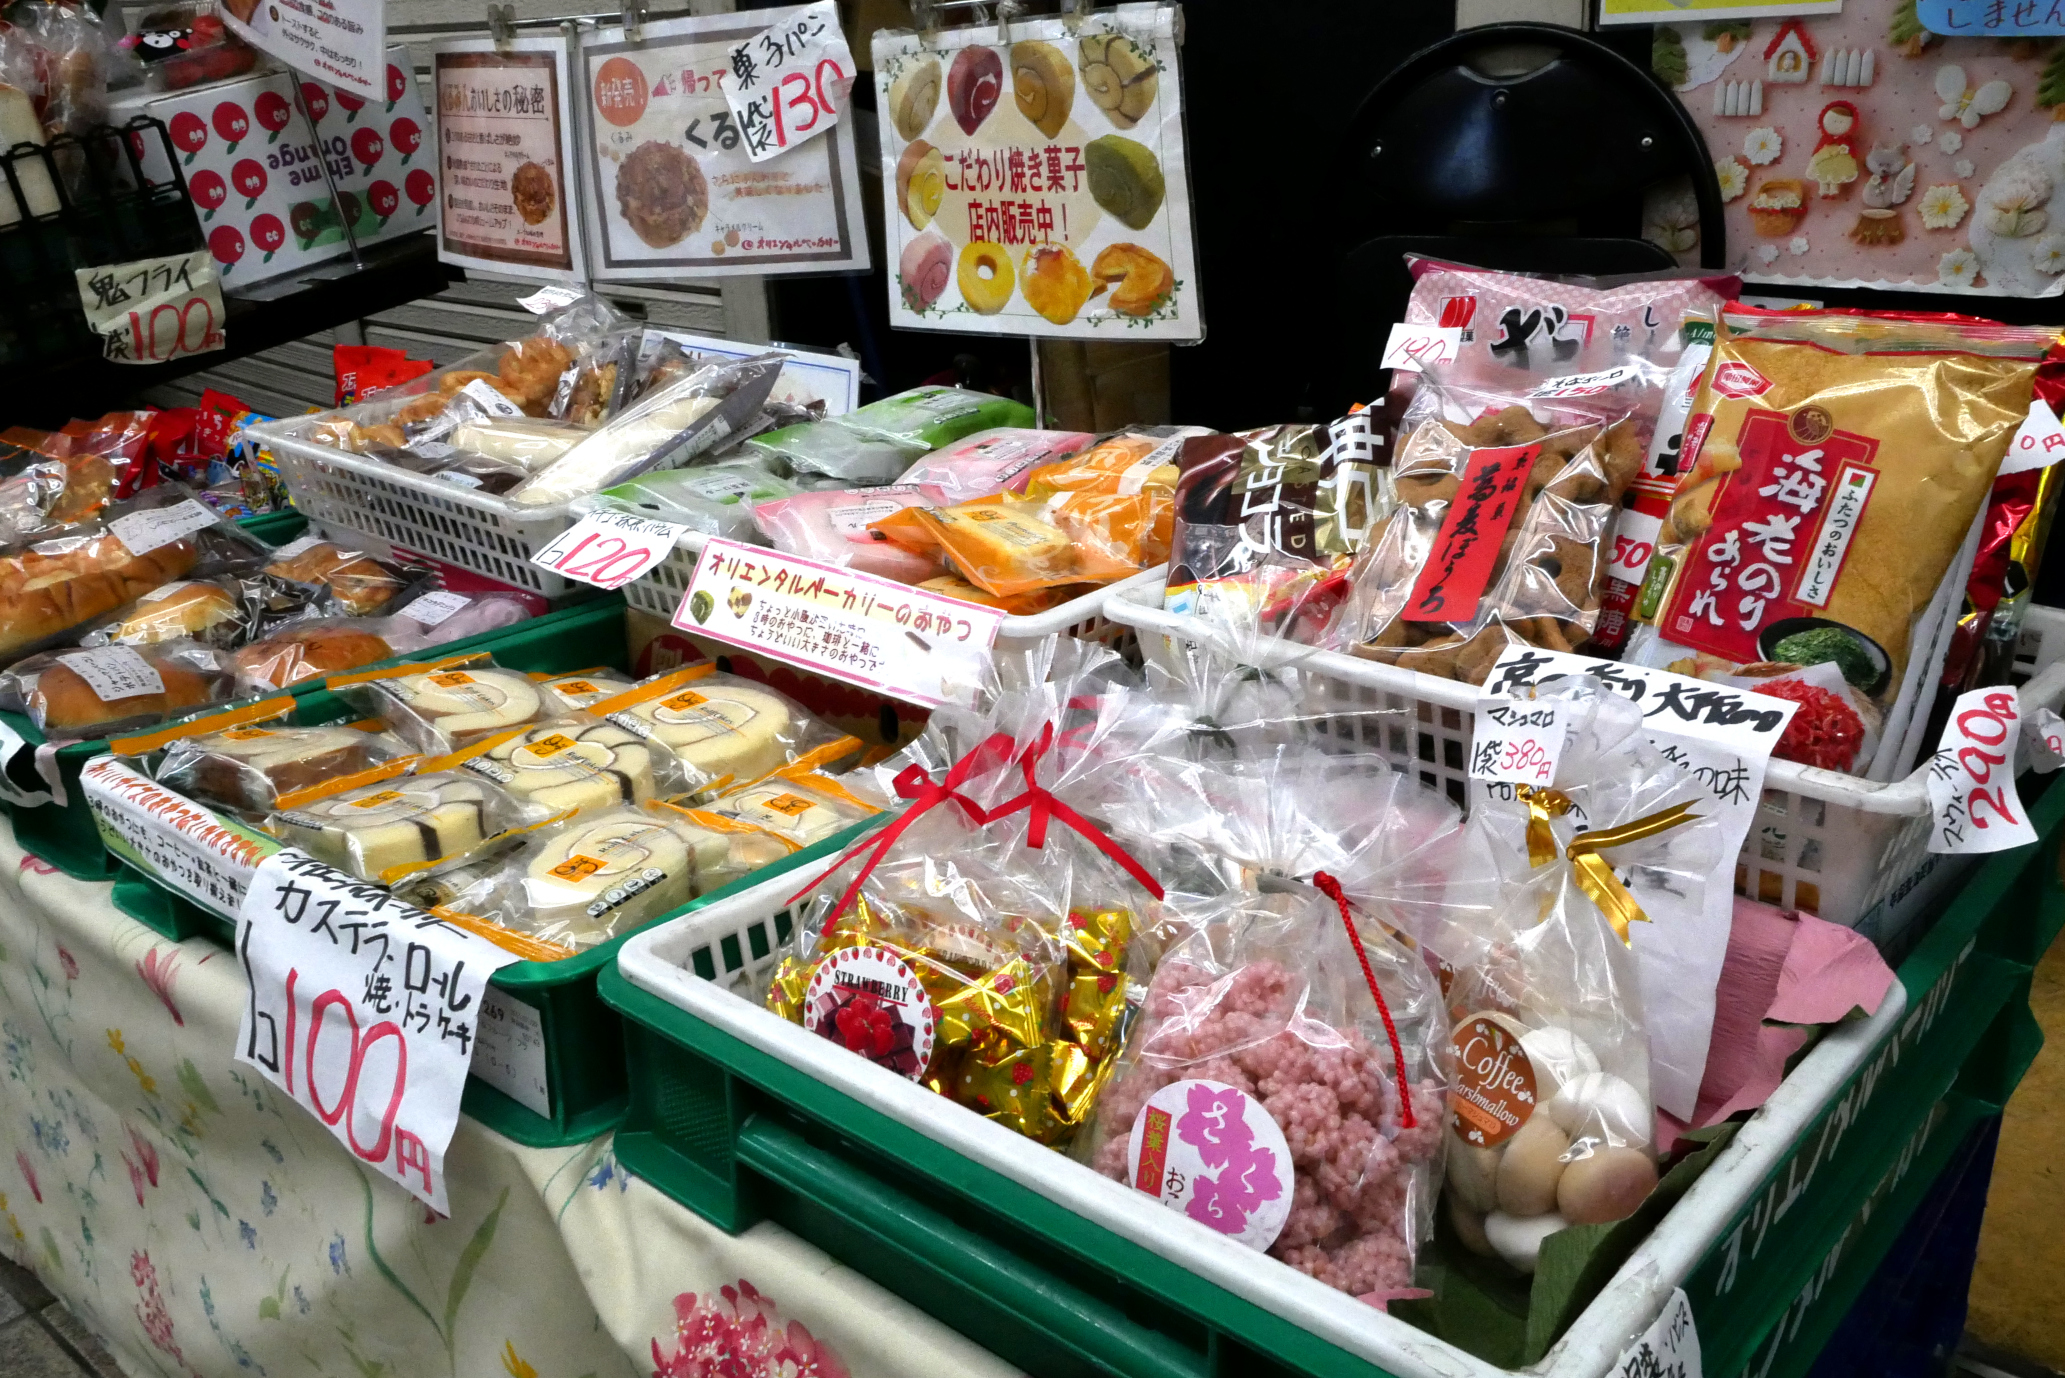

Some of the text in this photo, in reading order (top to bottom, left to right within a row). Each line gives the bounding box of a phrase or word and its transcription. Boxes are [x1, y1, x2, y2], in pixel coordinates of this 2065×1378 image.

[731, 16, 826, 90] 菓子パン
[288, 155, 355, 187] Ehme
[943, 145, 1086, 194] こだわり焼き菓子
[967, 199, 1069, 245] 店内販売中！
[1804, 488, 1860, 601] ふたつのおいしさ
[708, 552, 973, 642] オリエンタルベーカリーのおやつ
[1686, 529, 1742, 627] あられ
[1471, 738, 1552, 780] 1袋380円
[833, 969, 909, 1003] STRAWBERRY
[1462, 1036, 1525, 1096] Coffee
[1456, 1073, 1520, 1128] arshmallow
[1141, 1109, 1168, 1189] 桜葉入り
